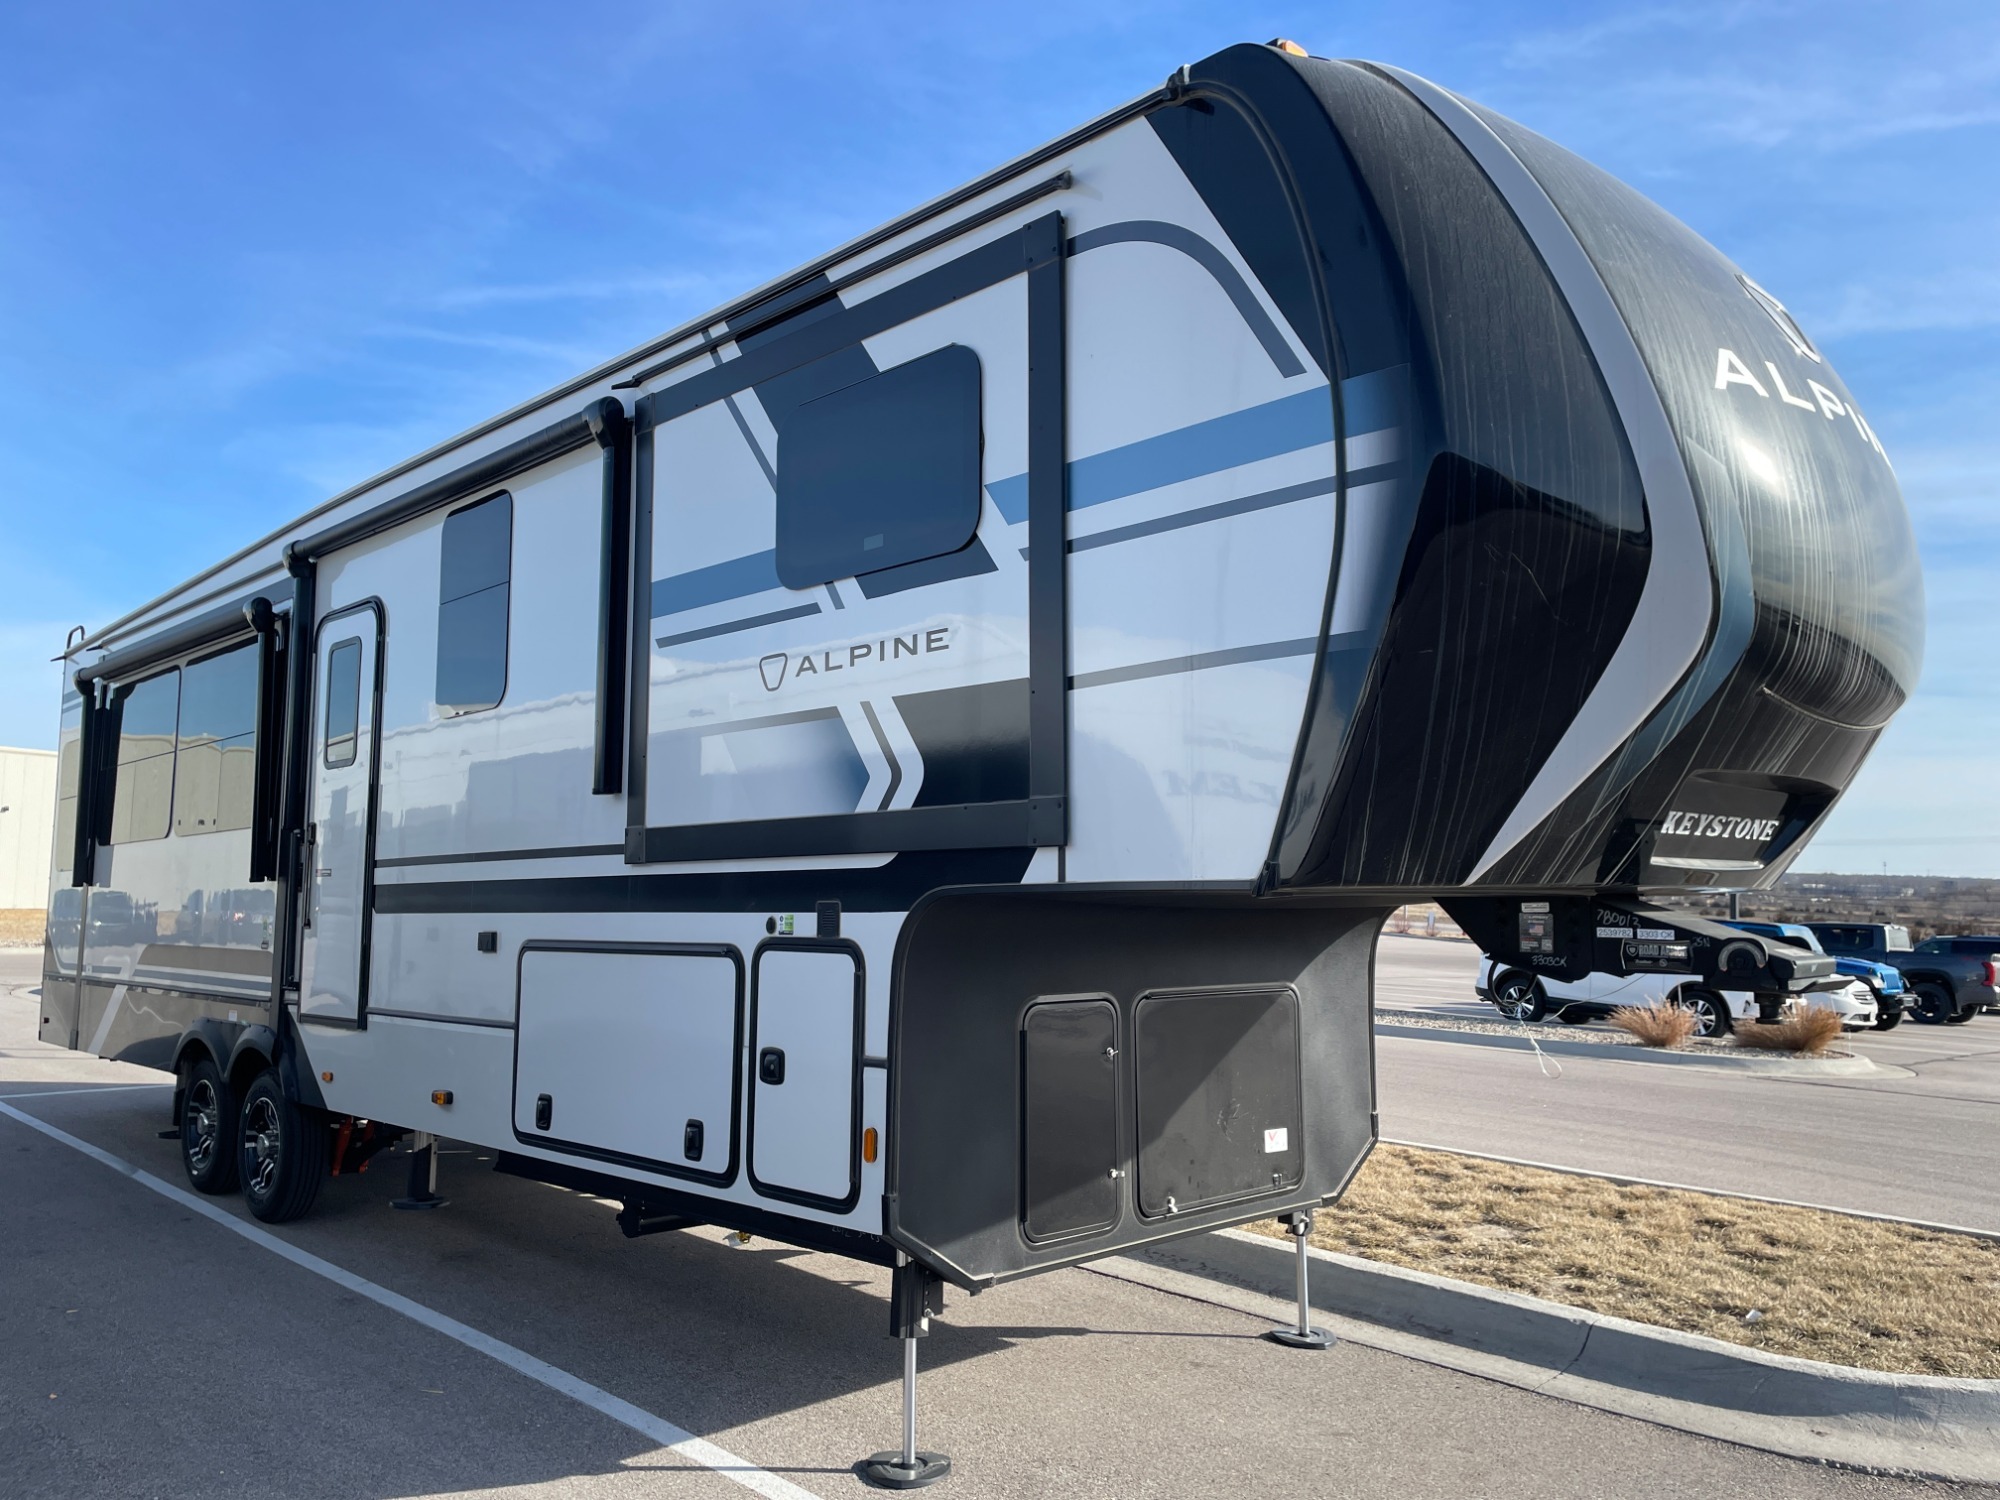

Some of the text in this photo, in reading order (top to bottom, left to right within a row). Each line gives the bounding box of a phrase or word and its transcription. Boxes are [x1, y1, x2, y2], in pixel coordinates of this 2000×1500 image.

[795, 627, 949, 678] ALPINE
[1660, 810, 1780, 841] KEYSTONE
[1638, 944, 1659, 957] ROAD
